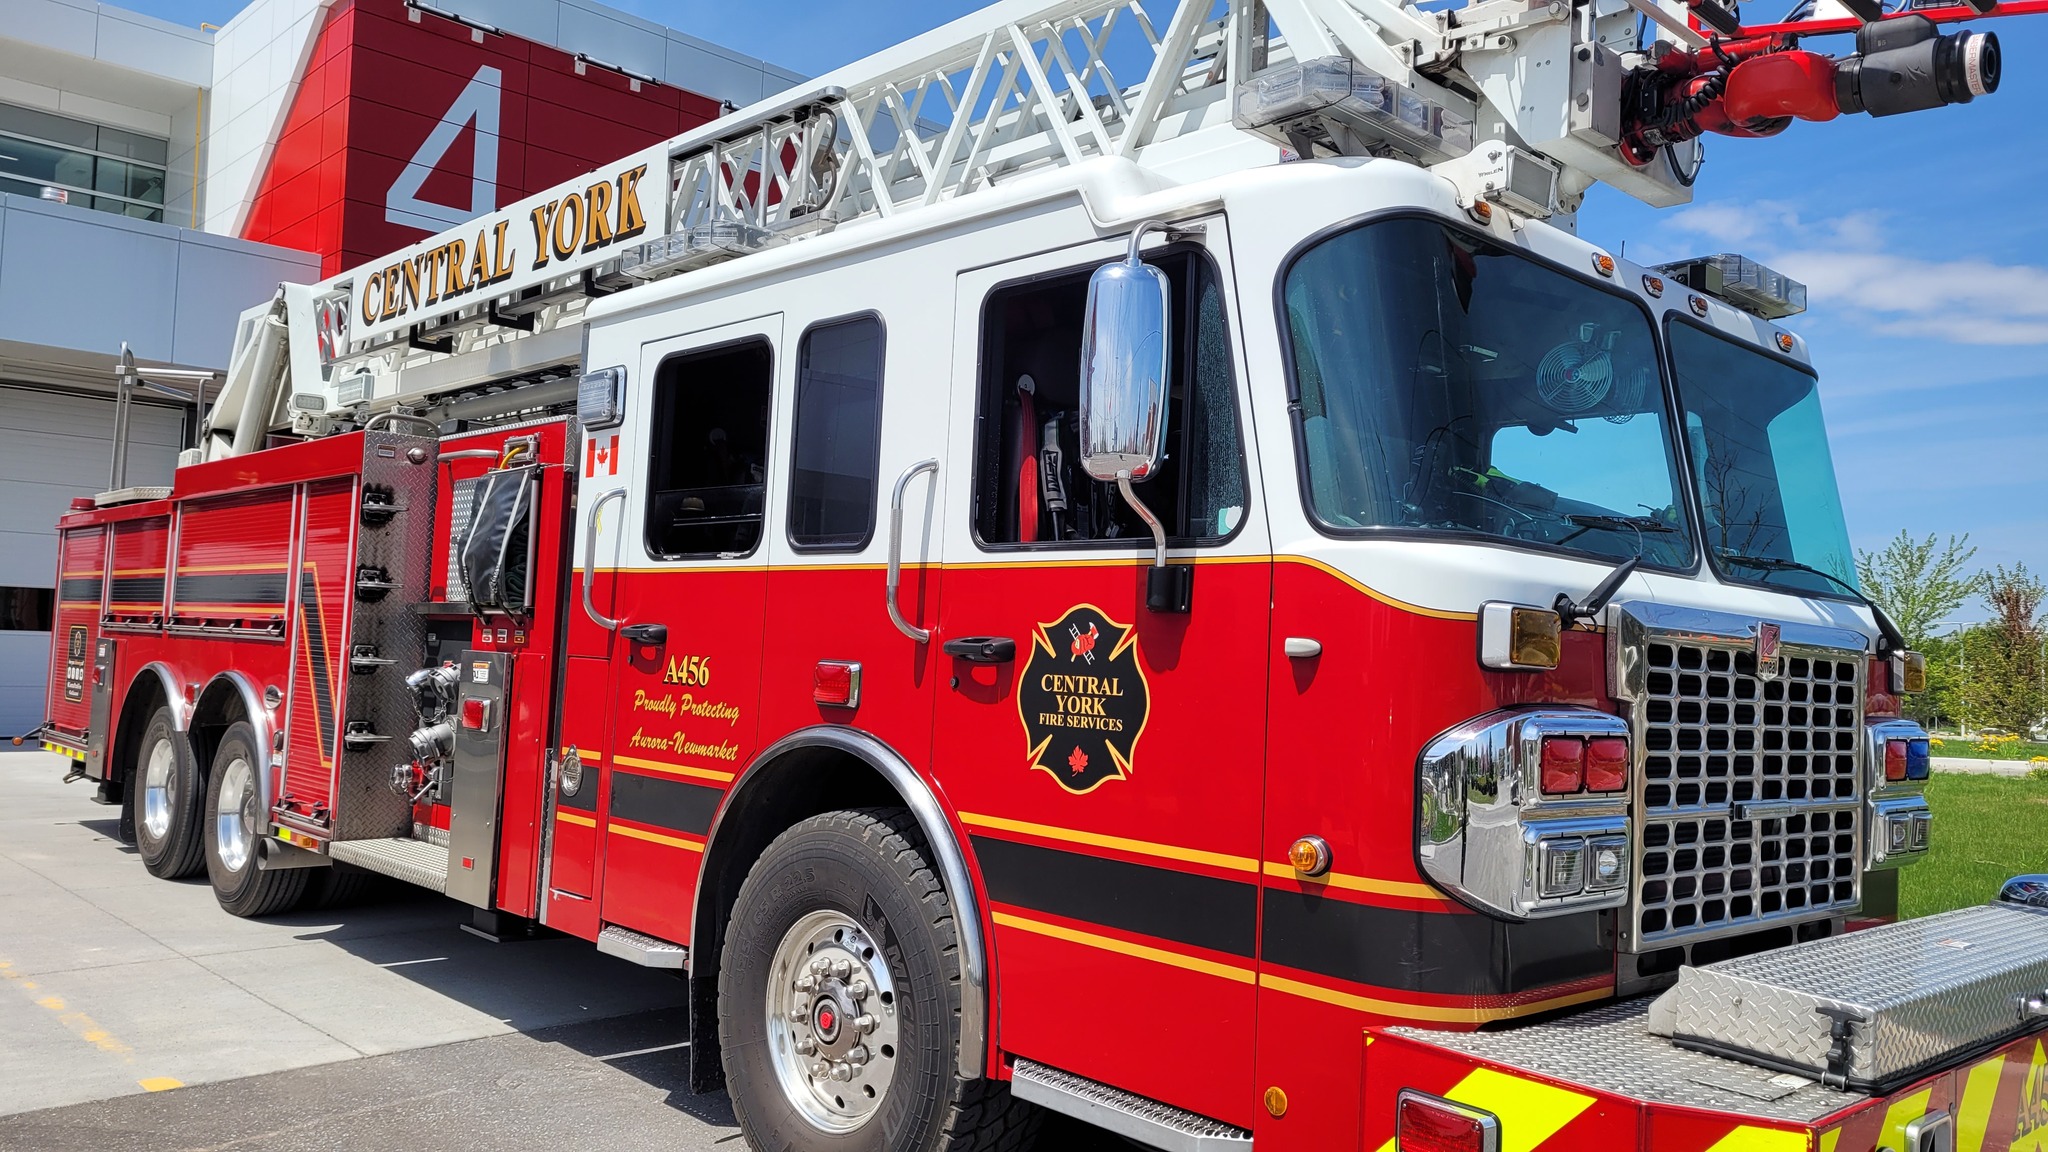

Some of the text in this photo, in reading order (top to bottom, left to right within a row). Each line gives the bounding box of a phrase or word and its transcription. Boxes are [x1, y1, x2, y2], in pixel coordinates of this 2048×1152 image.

[385, 64, 502, 234] 4
[362, 163, 648, 327] CENTRAL YORK
[662, 654, 711, 688] A456
[1041, 673, 1124, 697] CENTRAL
[633, 689, 740, 727] Proudly Protecting
[1055, 694, 1106, 716] YORK
[1039, 713, 1124, 732] FIRE SERVICES
[629, 726, 739, 761] Aurora-Newmarket
